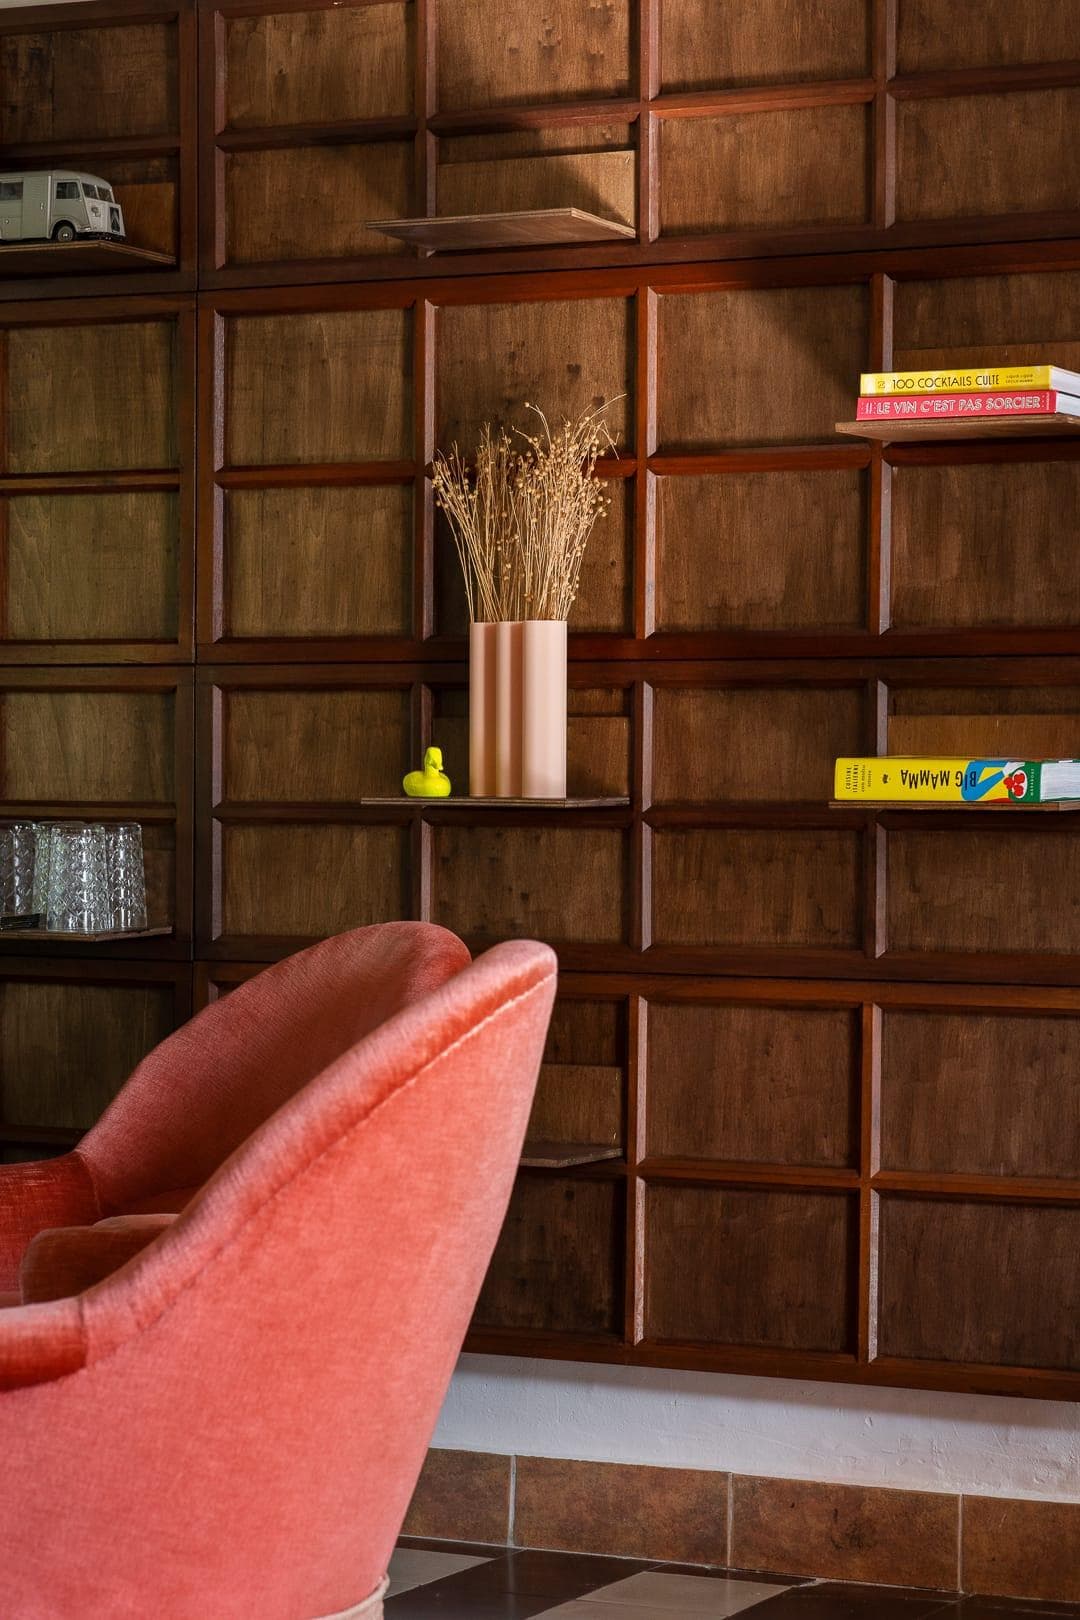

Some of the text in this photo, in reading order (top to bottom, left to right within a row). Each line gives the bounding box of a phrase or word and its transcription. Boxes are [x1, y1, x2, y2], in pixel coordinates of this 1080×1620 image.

[892, 378, 915, 390] 100
[917, 376, 972, 389] COCKTAILS
[975, 374, 1000, 386] CULTE
[876, 402, 891, 415] LE
[893, 401, 917, 414] VIN
[920, 400, 955, 413] C'EST
[958, 398, 982, 411] PAS
[985, 396, 1041, 410] SORCIER
[900, 769, 977, 791] BIG MAMMA
